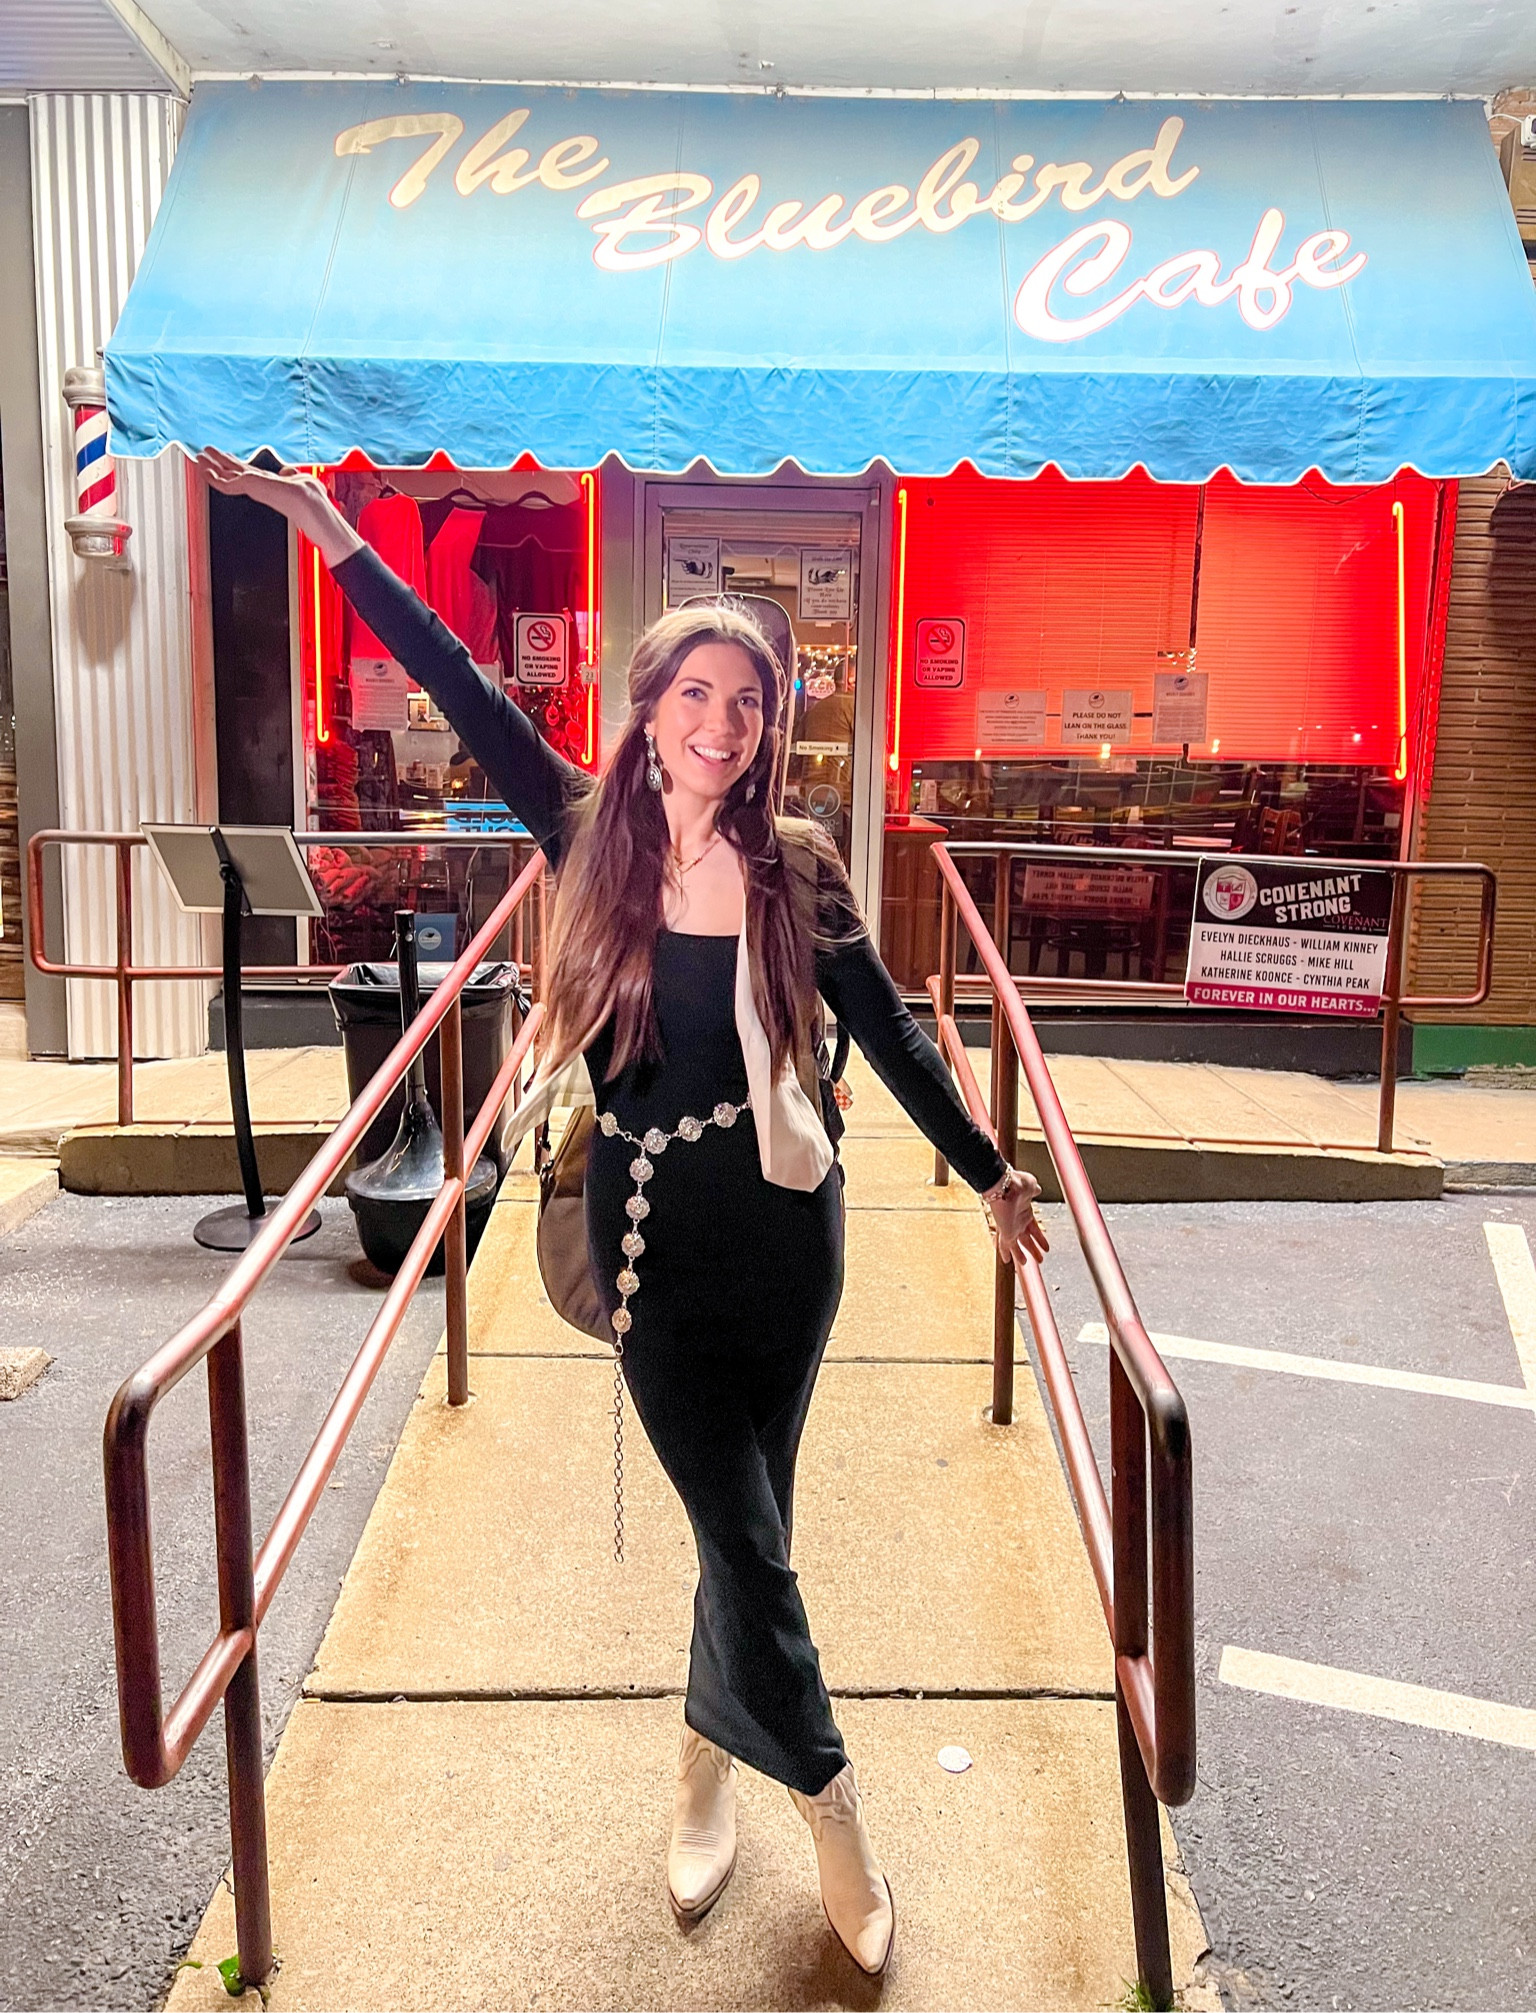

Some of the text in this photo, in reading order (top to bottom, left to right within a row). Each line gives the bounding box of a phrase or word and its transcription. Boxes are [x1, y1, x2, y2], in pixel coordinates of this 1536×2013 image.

[334, 107, 610, 210] The
[576, 115, 1201, 272] Bluebird
[1014, 207, 1368, 343] Cafe
[1064, 722, 1081, 730] LEAN
[1082, 722, 1092, 730] ON
[1259, 873, 1362, 907] COVENANT
[1275, 896, 1351, 924] STRONG
[1323, 914, 1388, 928] COVENANT
[1201, 930, 1235, 944] EVELYN
[1238, 933, 1290, 948] DIECKHAUS
[1300, 938, 1341, 951] WILLIAM
[1343, 941, 1379, 955] KINNEY
[1220, 949, 1253, 963] HALLIE
[1255, 952, 1298, 966] SCRUGGS
[1307, 956, 1331, 969] MIKE
[1333, 959, 1354, 971] HILL
[1201, 966, 1253, 981] KATHERINE
[1255, 970, 1293, 983] KOONCE
[1303, 973, 1343, 988] CYNTHIA
[1345, 977, 1370, 990] PEAK
[1194, 987, 1376, 1013] FOREVER IN OUR HEARTS...
